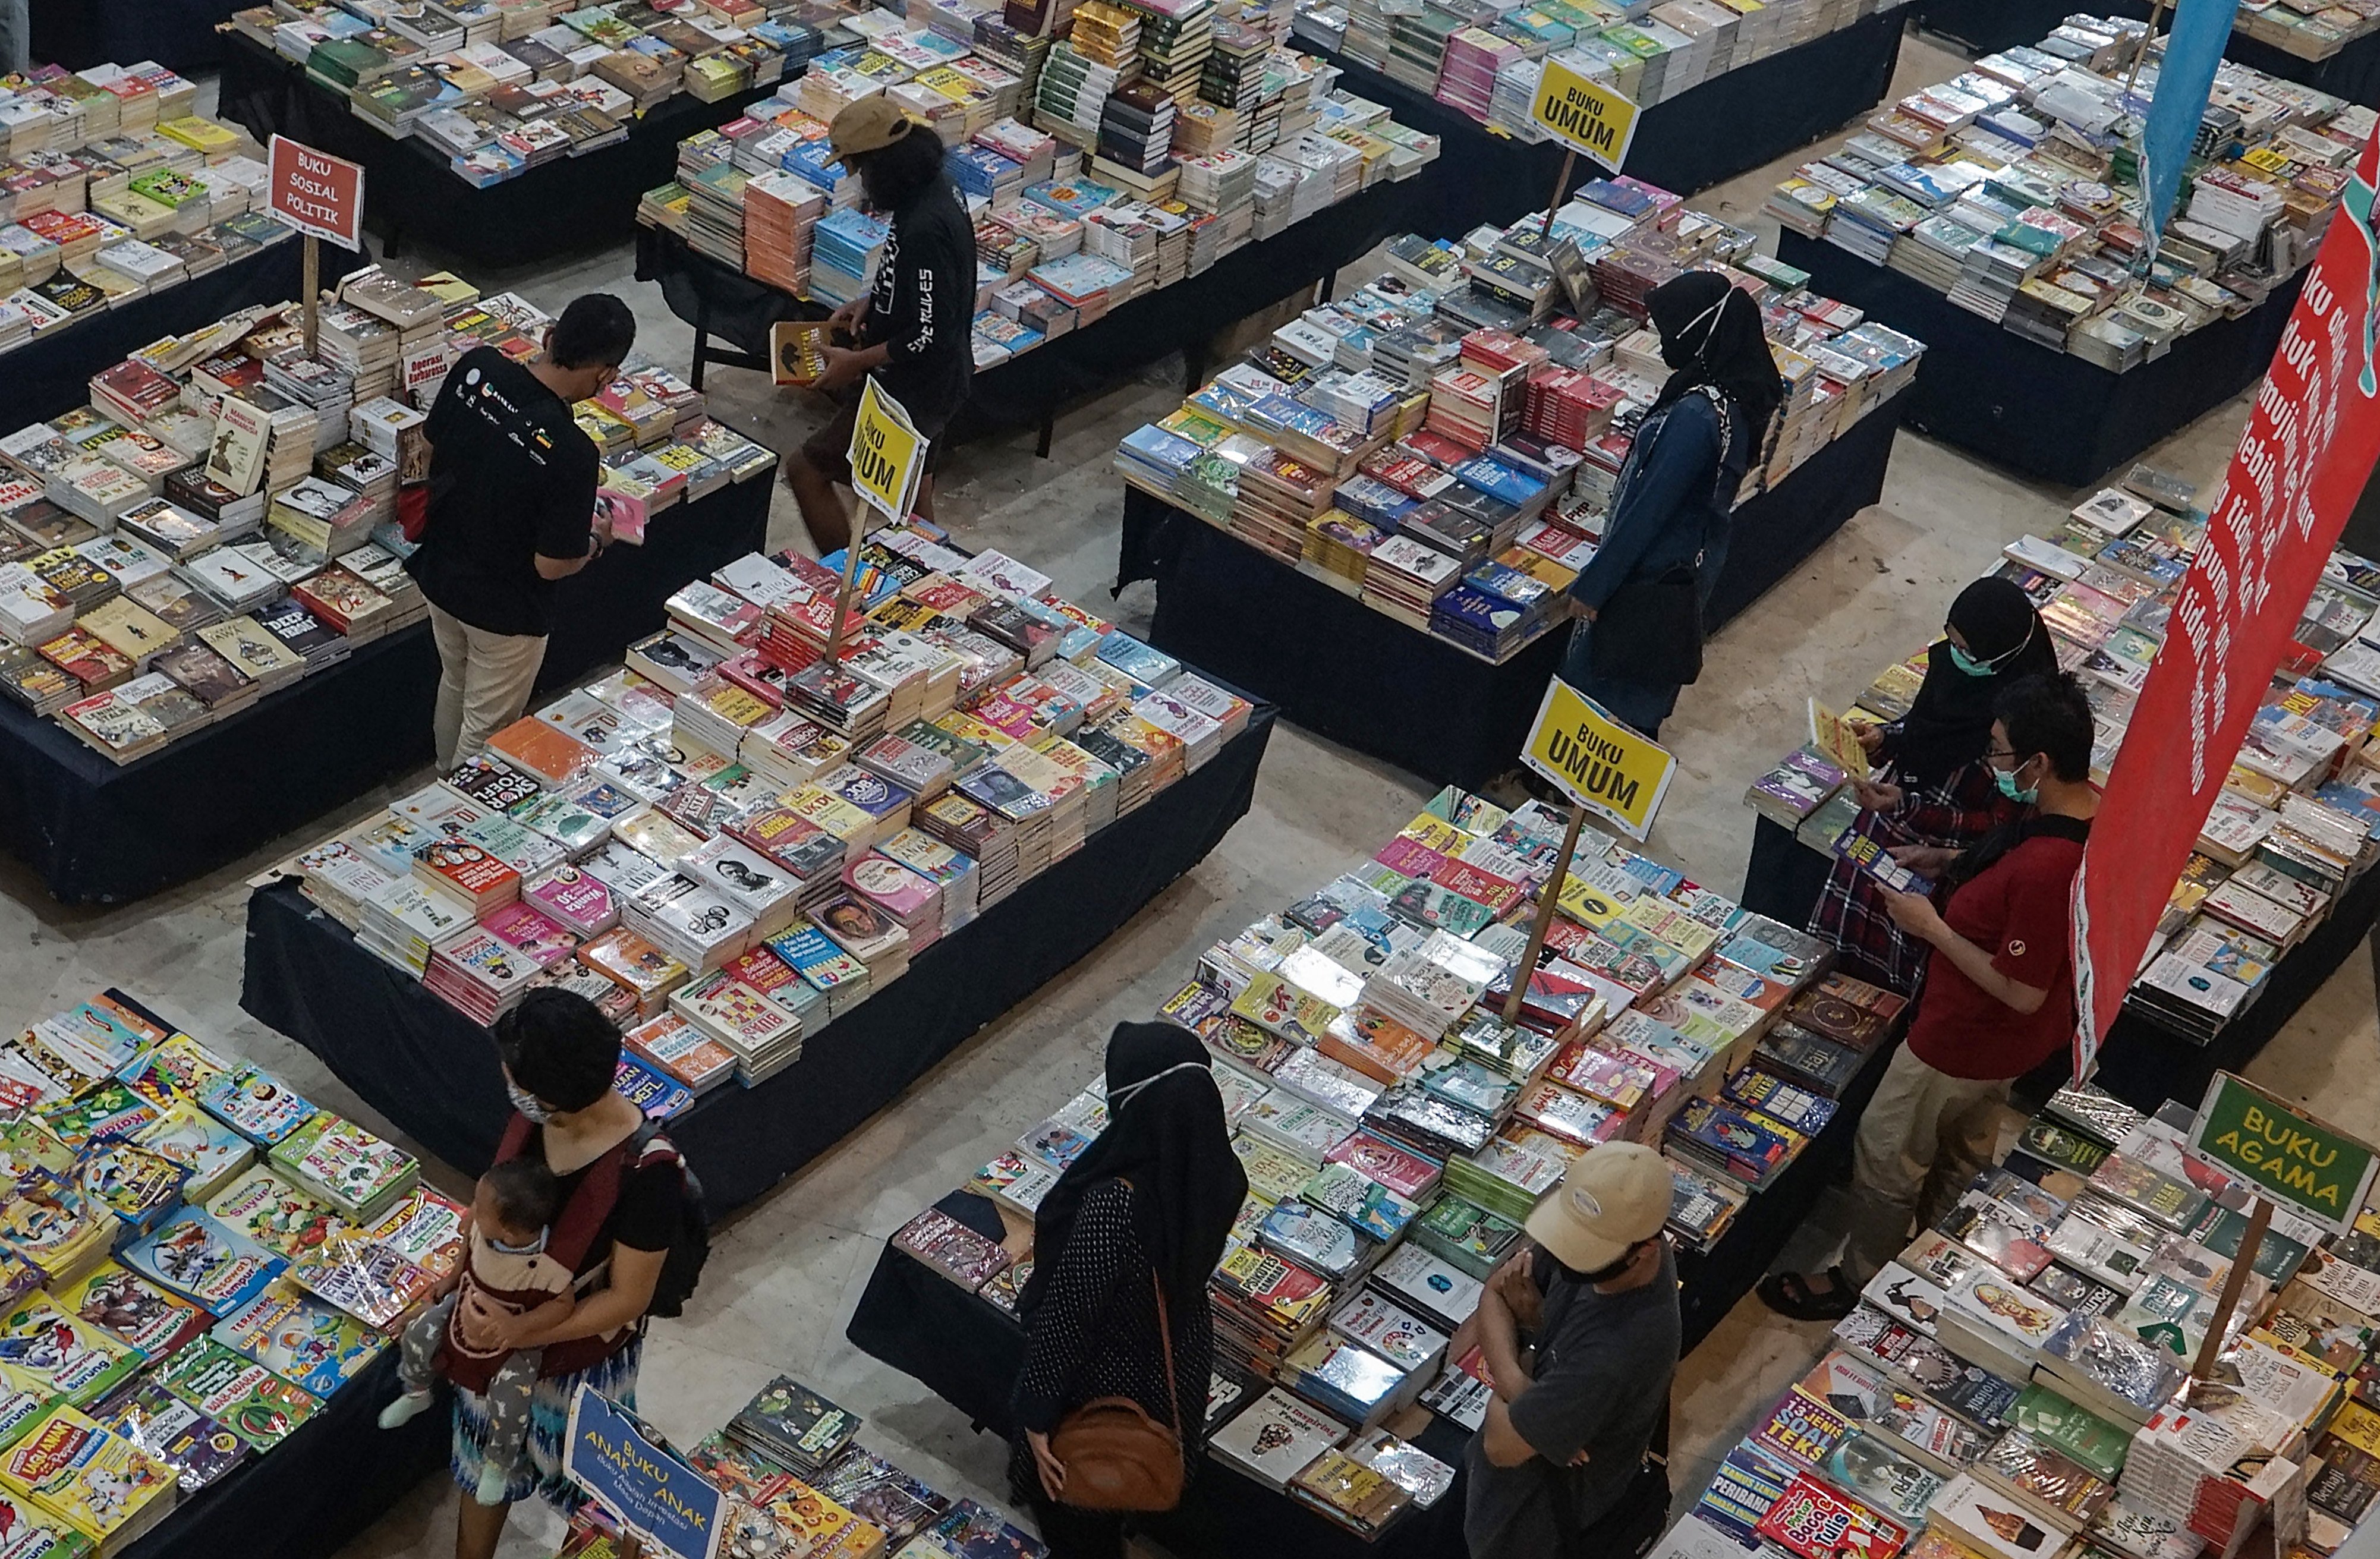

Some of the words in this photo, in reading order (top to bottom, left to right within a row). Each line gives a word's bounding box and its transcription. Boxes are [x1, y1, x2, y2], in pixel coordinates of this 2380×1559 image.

[1567, 86, 1604, 116] BUKU
[1544, 95, 1615, 151] UMUM
[298, 152, 331, 177] BUKU
[289, 172, 338, 202] SOSIAL
[287, 193, 338, 225] POLITIK
[1567, 502, 1589, 522] PHP
[1577, 723, 1624, 764] BUKU
[1548, 729, 1639, 810] UMUM
[473, 772, 525, 802] TOEFL
[556, 892, 575, 905] 30
[565, 890, 605, 912] Wanita
[2243, 1106, 2337, 1167] BUKU
[2215, 1131, 2338, 1207] AGAMA
[230, 1188, 269, 1216] Sayur
[207, 1262, 246, 1295] Pesawat
[219, 1271, 255, 1297] Tempur
[1241, 1255, 1279, 1290] PSIKOTES
[133, 1310, 174, 1344] Mewarnai
[230, 1297, 276, 1333] TERAMPIL
[240, 1330, 263, 1350] LUAR
[262, 1298, 302, 1333] ANGKASA
[54, 1350, 97, 1382] Mewarnai
[67, 1360, 111, 1390] Burung
[1963, 1377, 2001, 1411] Holistik
[1267, 1392, 1292, 1411] Most
[1293, 1409, 1339, 1437] Inspiring
[1279, 1410, 1312, 1430] People
[1777, 1409, 1836, 1448] SOAL
[1788, 1400, 1805, 1417] 13
[1805, 1413, 1843, 1440] JENIS
[22, 1447, 49, 1475] LAGU
[44, 1422, 73, 1450] ANAK
[1768, 1420, 1825, 1461] TEKS
[624, 1440, 669, 1483] BUKU
[585, 1431, 631, 1476] ANAK
[654, 1488, 706, 1532] ANAK
[597, 1454, 618, 1476] Buku
[648, 1497, 688, 1530] Investasi
[1888, 1466, 1922, 1495] GURU
[613, 1480, 634, 1504] Masa
[635, 1502, 665, 1525] Depan
[1787, 1500, 1813, 1527] Pintar
[1787, 1509, 1827, 1544] Baca
[1815, 1514, 1850, 1547] Tulis
